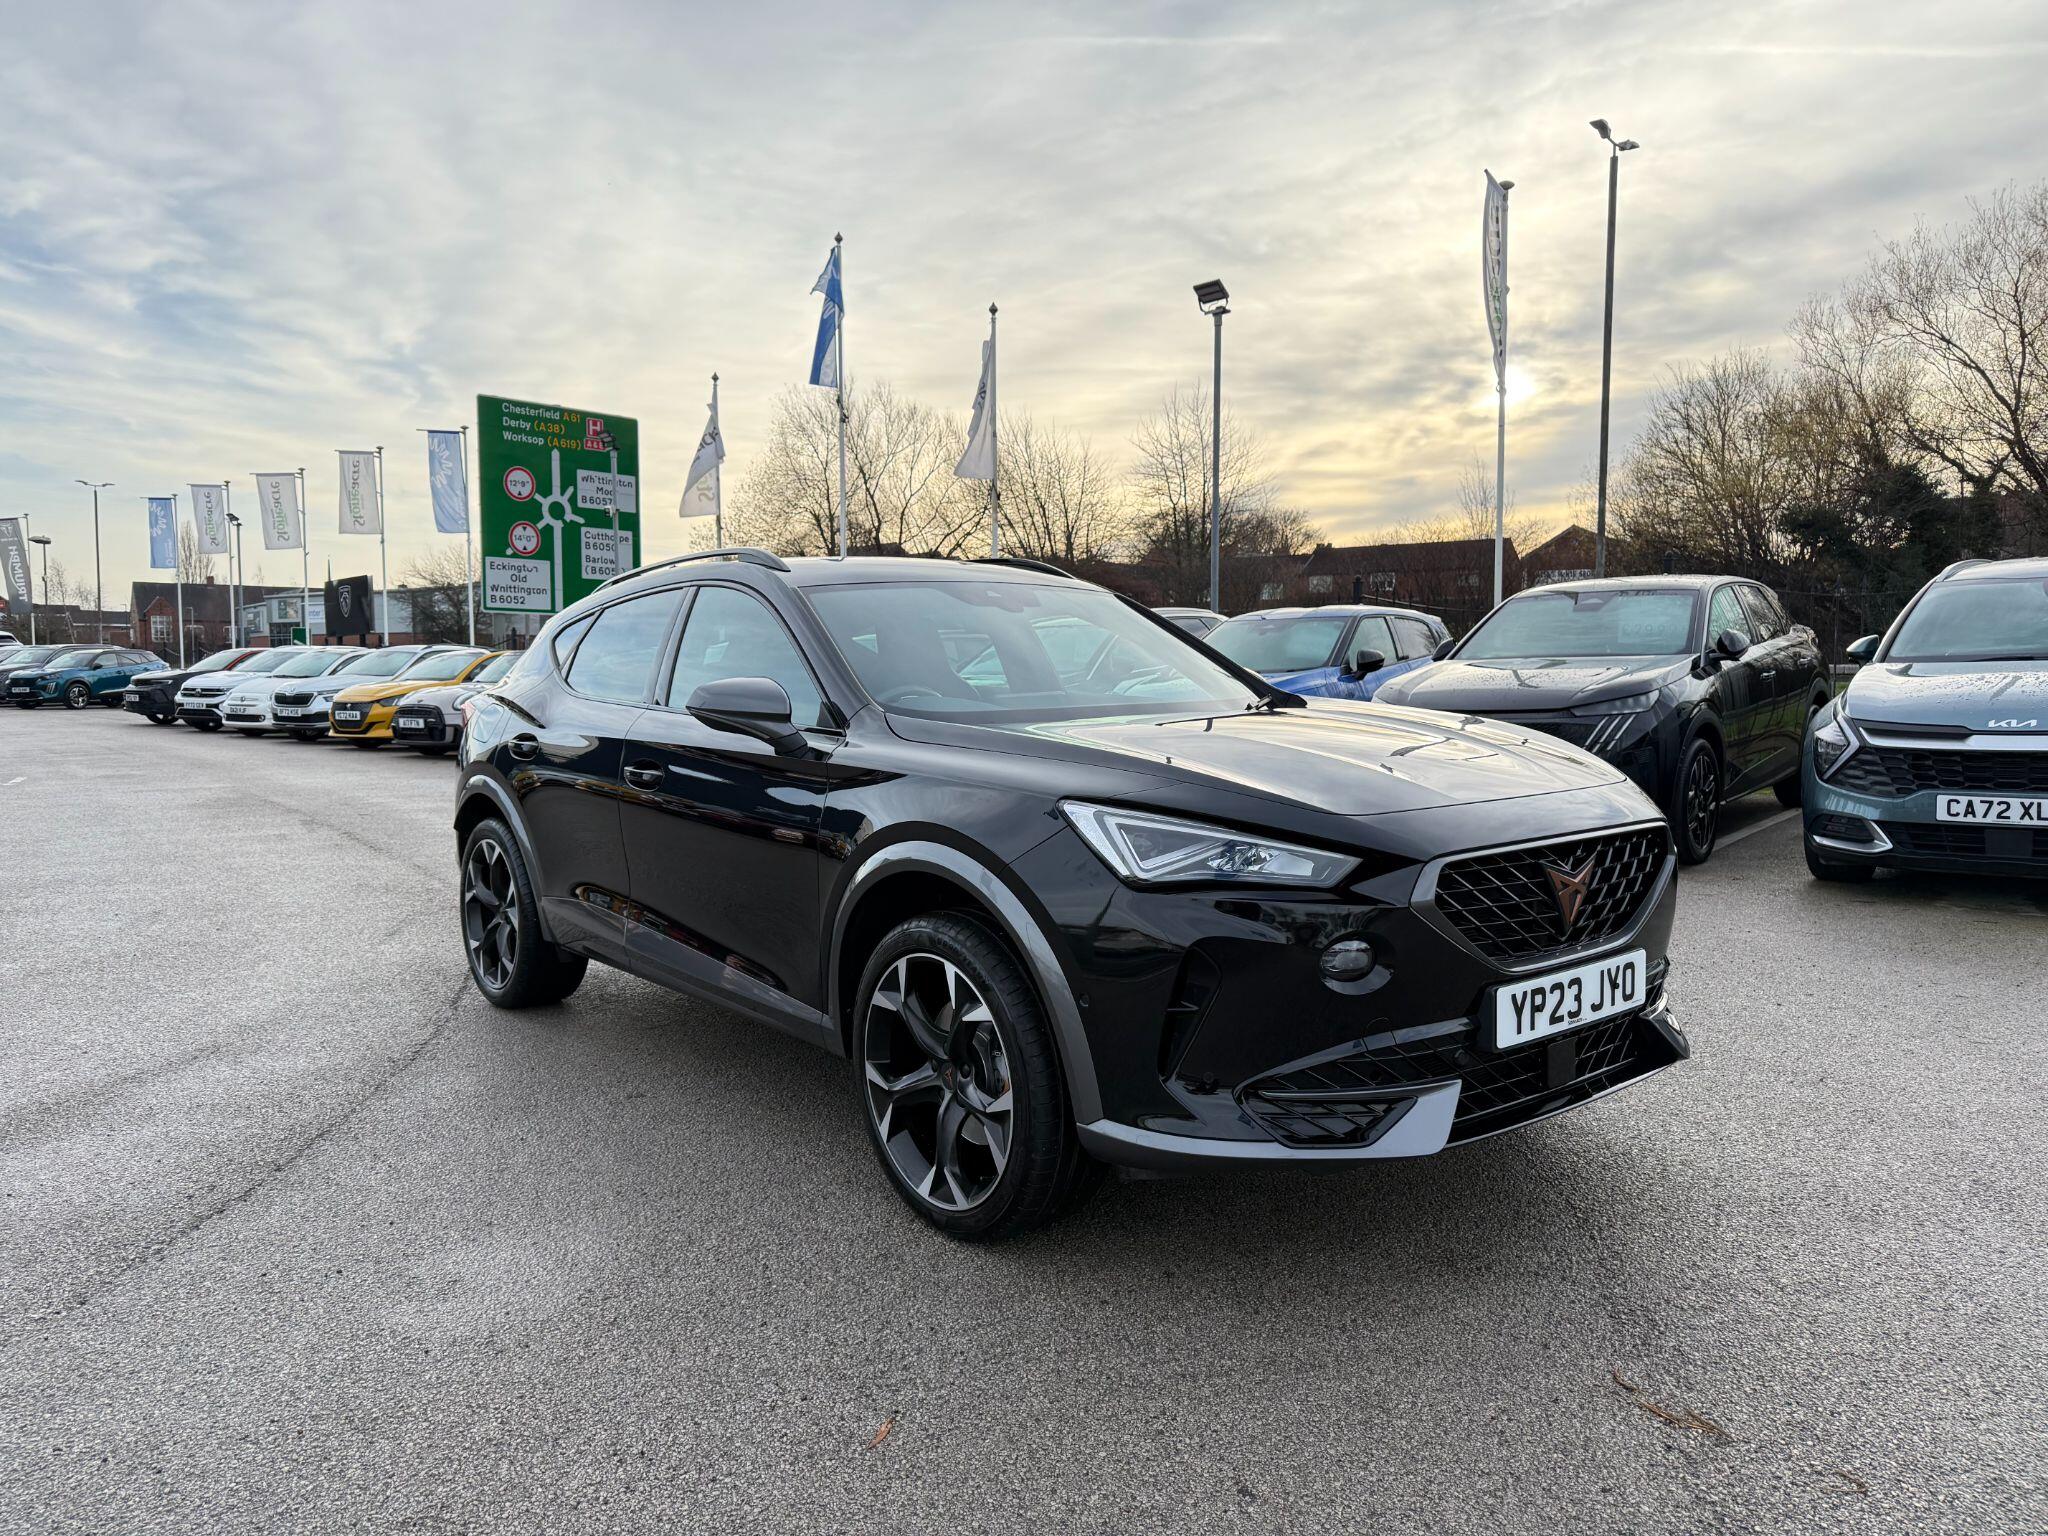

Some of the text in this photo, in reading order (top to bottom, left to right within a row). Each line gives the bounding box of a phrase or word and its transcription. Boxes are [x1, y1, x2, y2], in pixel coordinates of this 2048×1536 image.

[502, 403, 580, 423] Chesterfield A61
[502, 417, 566, 435] Derby (A38)
[502, 431, 582, 451] Worksop (A619)
[584, 531, 630, 544] Cutthope
[585, 555, 615, 565] Barlow
[510, 573, 528, 583] Old
[490, 595, 526, 605] B6052
[1946, 798, 2011, 820] CA72
[1511, 961, 1636, 1035] YP23 JYO
